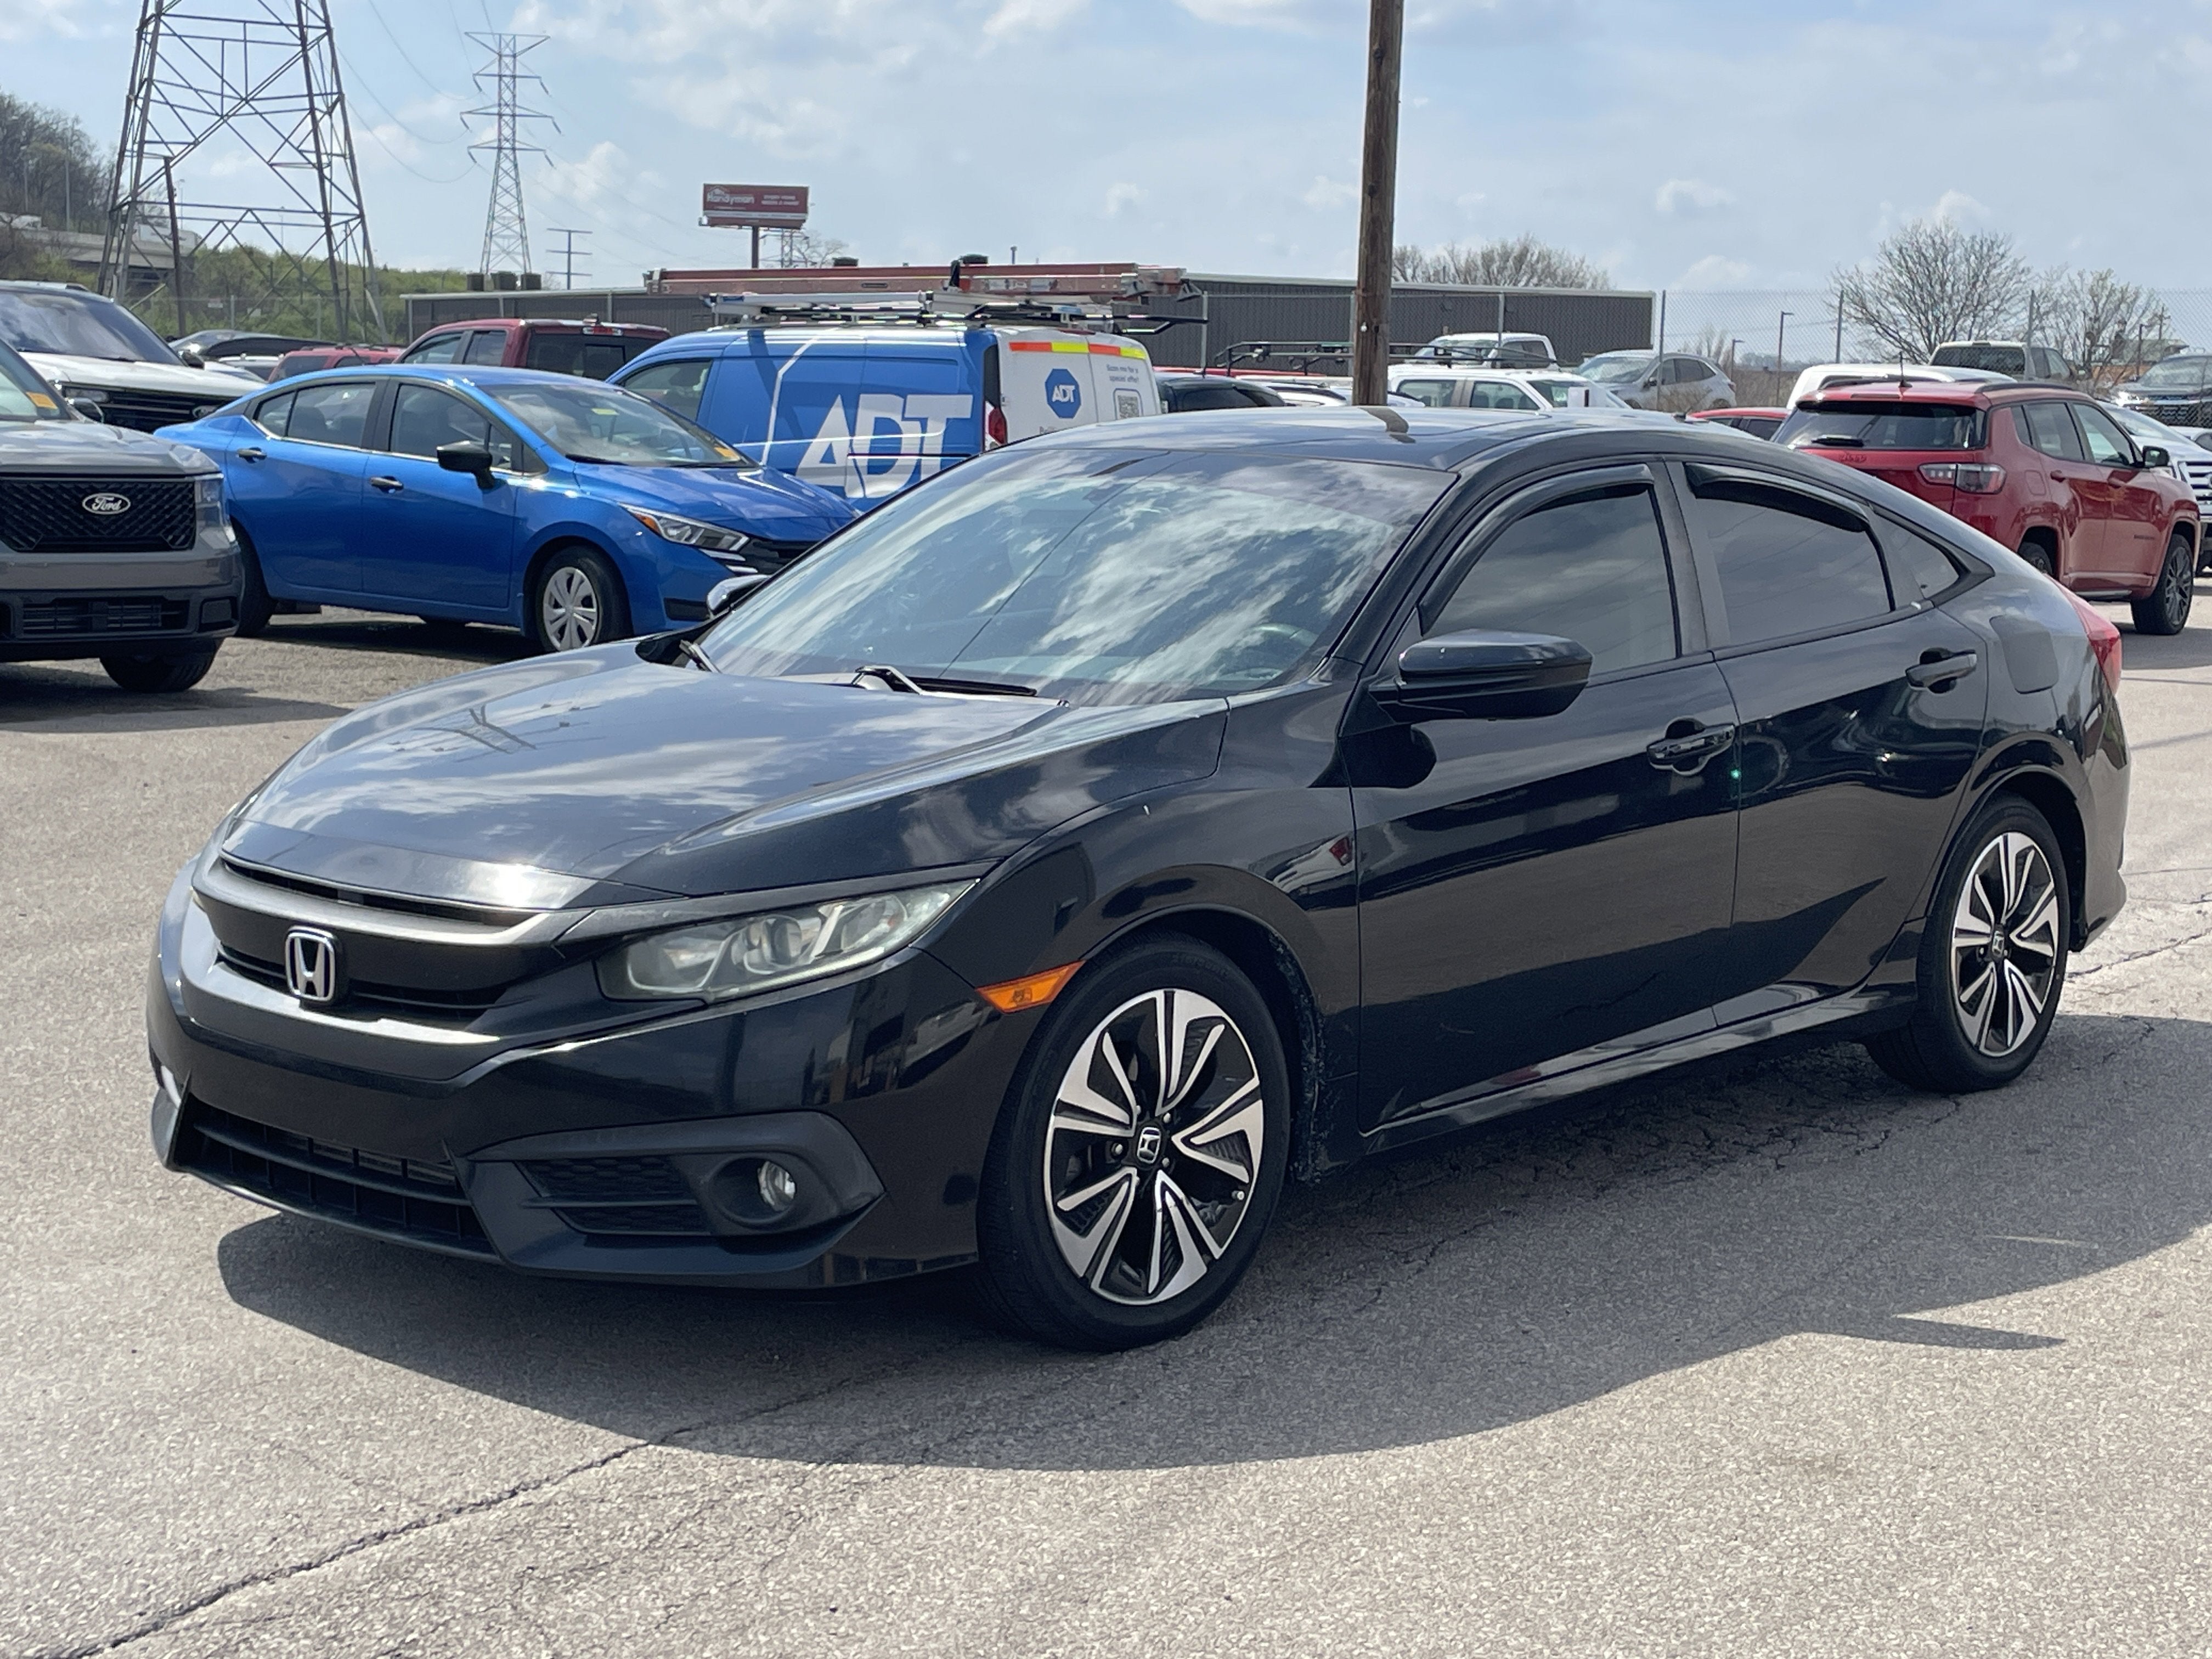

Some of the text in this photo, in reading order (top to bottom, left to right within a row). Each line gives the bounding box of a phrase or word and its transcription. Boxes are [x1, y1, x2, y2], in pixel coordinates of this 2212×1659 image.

[1052, 384, 1076, 403] ADT
[795, 394, 973, 498] ADT
[92, 496, 122, 510] Ford
